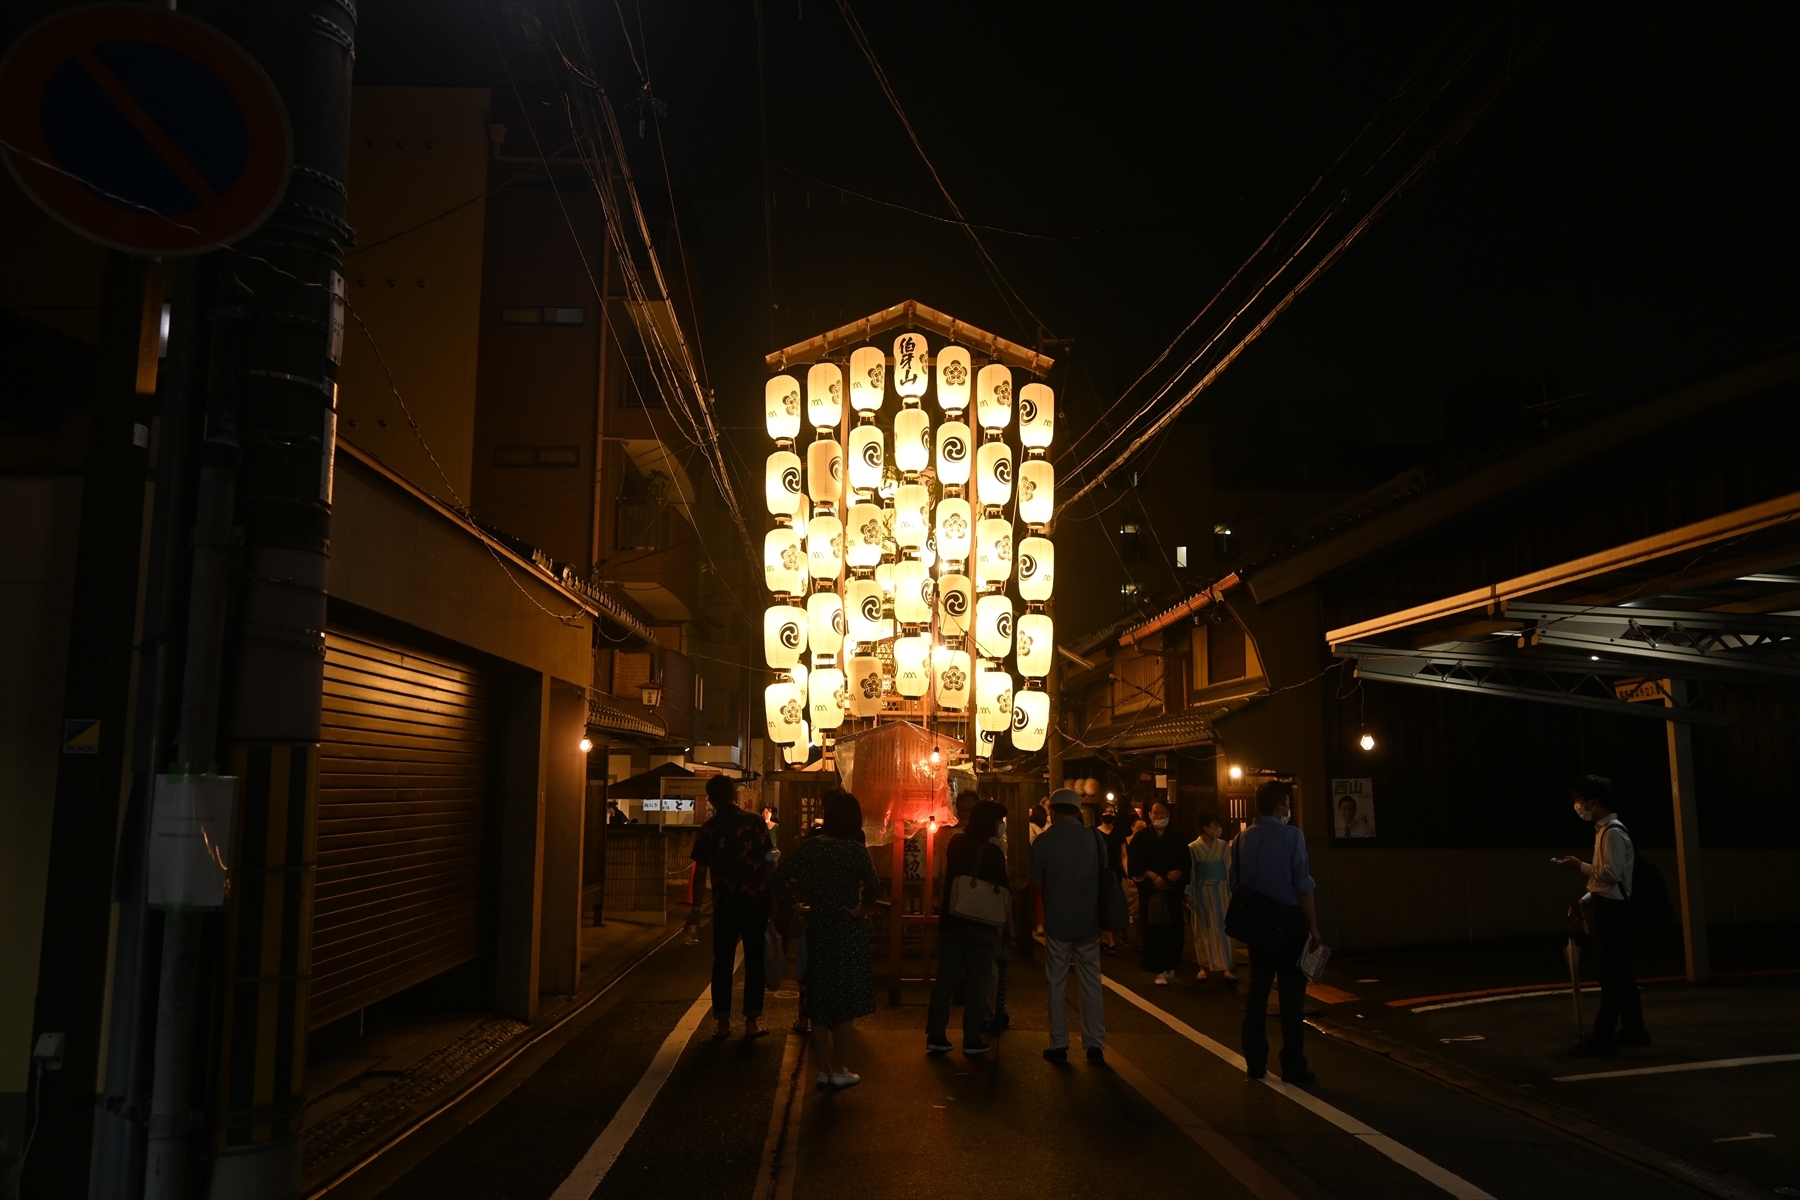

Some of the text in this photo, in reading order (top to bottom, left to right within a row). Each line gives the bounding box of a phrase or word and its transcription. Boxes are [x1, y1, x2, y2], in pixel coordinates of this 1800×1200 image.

[898, 336, 918, 387] 伯牙山
[1335, 780, 1363, 795] 西山
